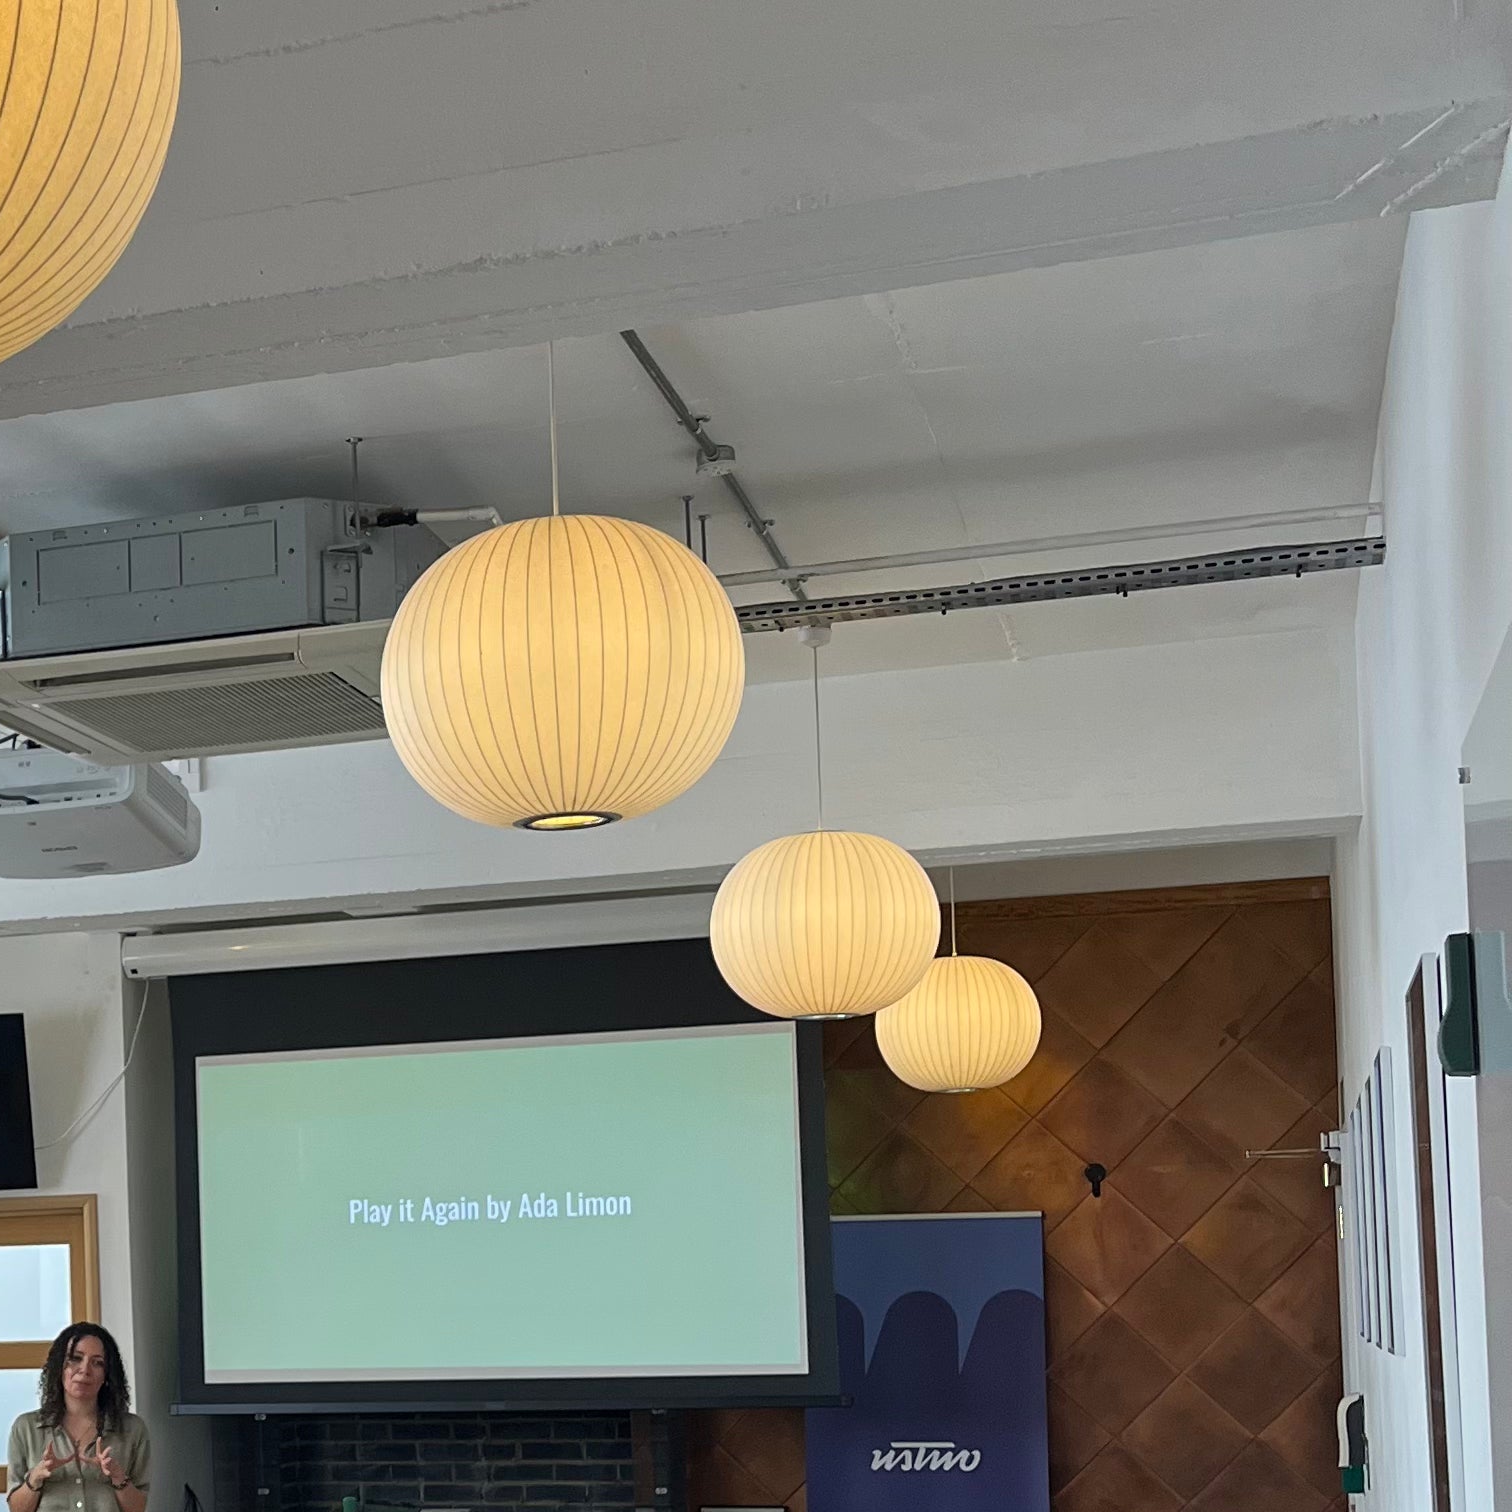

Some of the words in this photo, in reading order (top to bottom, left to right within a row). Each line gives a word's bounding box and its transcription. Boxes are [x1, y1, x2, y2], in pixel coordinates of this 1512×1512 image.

[349, 1199, 392, 1226] Play
[399, 1198, 414, 1222] it
[421, 1196, 479, 1226] Again
[487, 1195, 511, 1222] by
[518, 1193, 558, 1218] Ada
[566, 1192, 632, 1217] Limon
